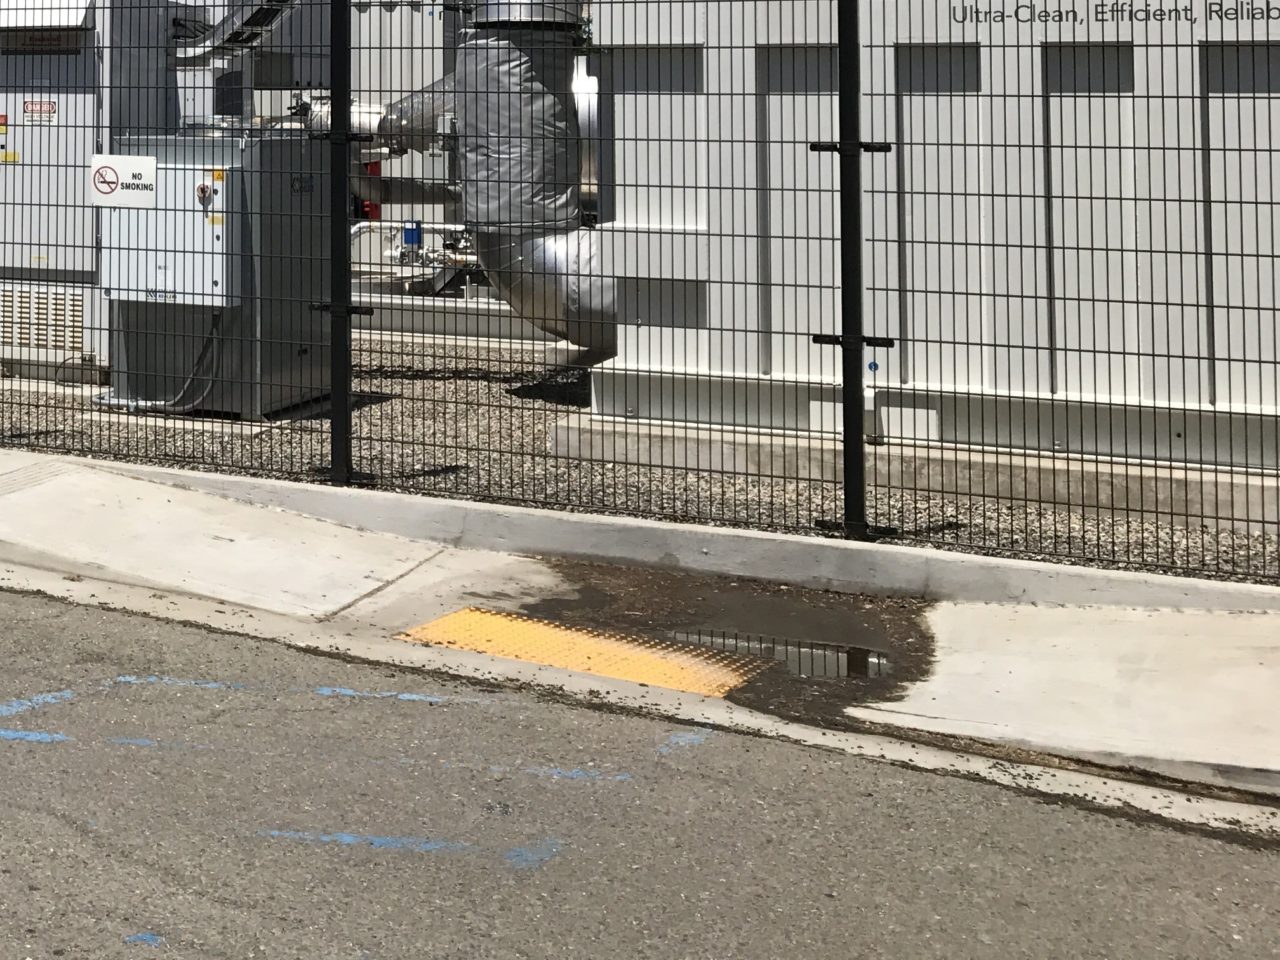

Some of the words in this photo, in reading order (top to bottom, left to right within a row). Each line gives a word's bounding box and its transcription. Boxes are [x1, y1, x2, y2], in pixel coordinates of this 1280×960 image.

[952, 3, 1085, 26] Ultra-Clean,
[1094, 2, 1198, 25] Efficient,
[131, 172, 143, 181] NO
[120, 182, 154, 192] SMOKING
